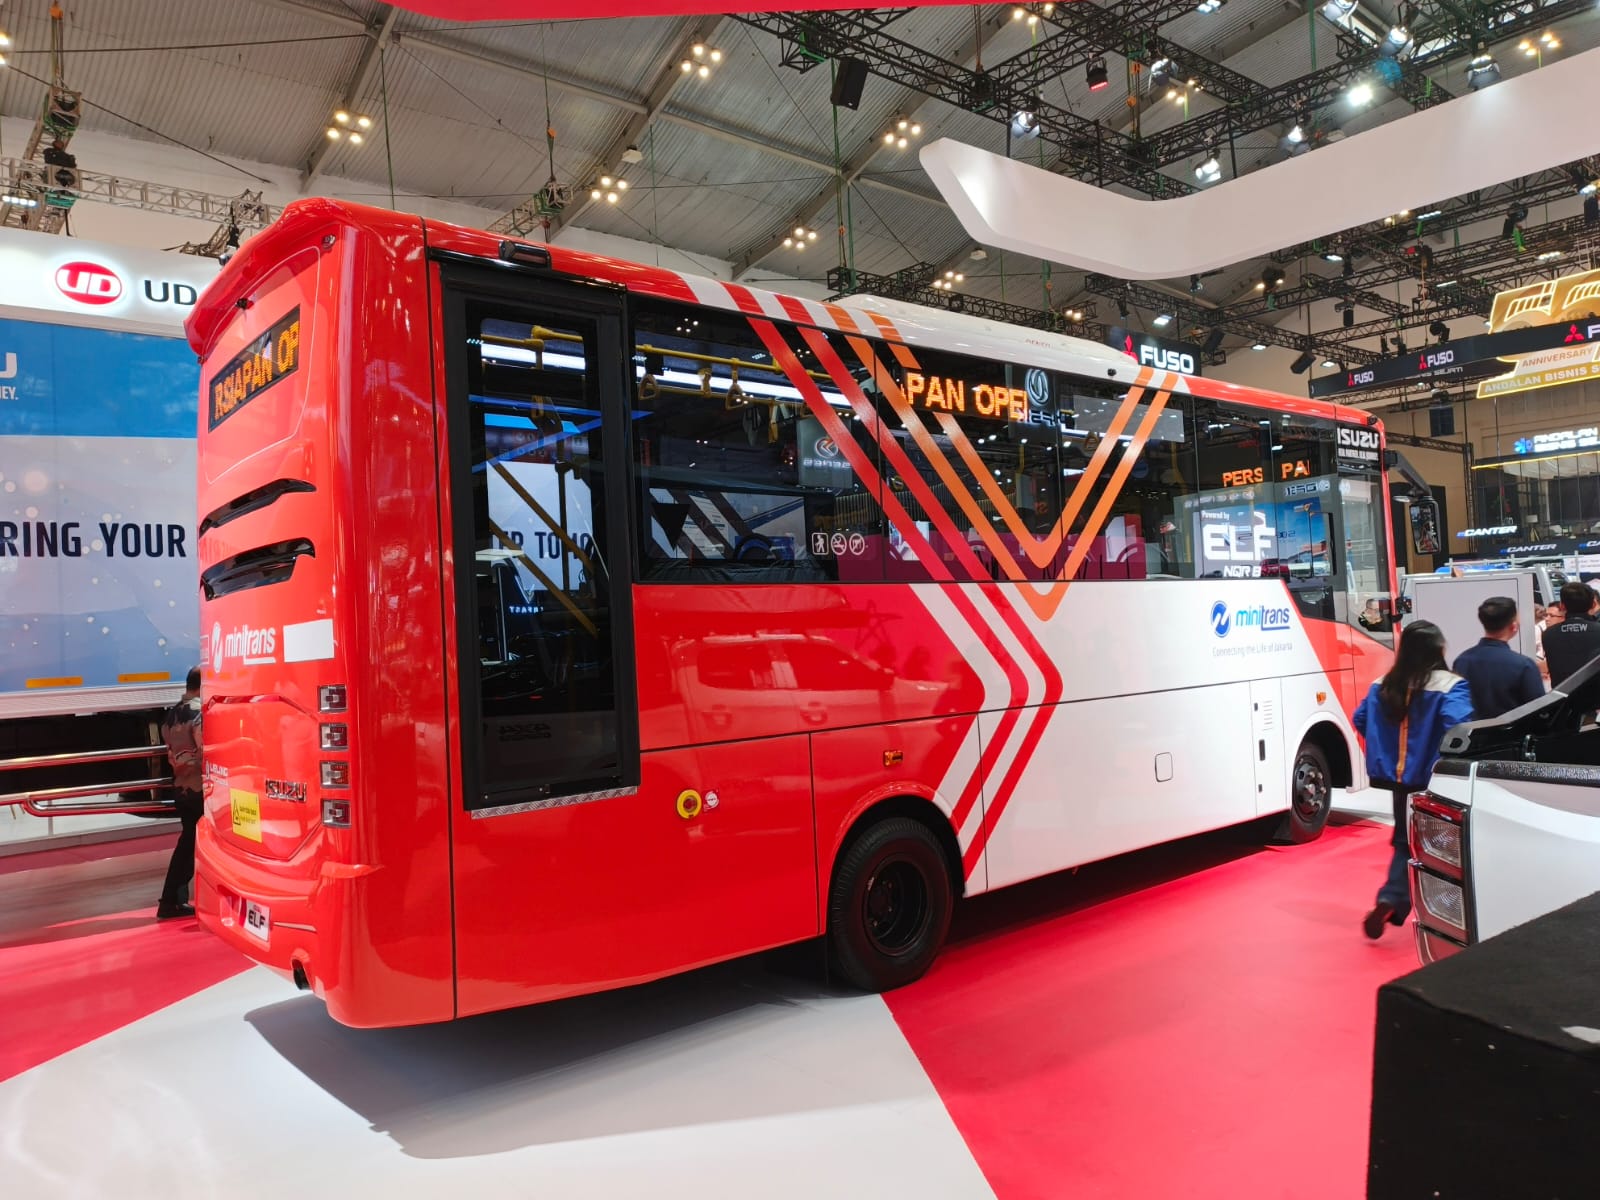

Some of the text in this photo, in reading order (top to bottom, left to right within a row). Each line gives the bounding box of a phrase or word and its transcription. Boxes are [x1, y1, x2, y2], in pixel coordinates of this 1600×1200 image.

[57, 269, 122, 298] UD
[144, 280, 198, 306] UD
[1140, 344, 1194, 374] FUSO
[1427, 350, 1454, 368] FUSO
[1522, 348, 1593, 367] ANNIVERSARY
[1354, 371, 1374, 385] FUSO
[1485, 377, 1541, 393] ANDALAN
[1545, 367, 1587, 384] BISNIS
[0, 385, 19, 400] EY.
[901, 372, 1029, 421] PAN OPE
[1337, 427, 1379, 449] ISUZU
[1221, 459, 1311, 488] PERS PA
[99, 523, 186, 557] YOUR
[1202, 524, 1276, 561] ELF
[1223, 565, 1251, 578] NQR
[1236, 605, 1290, 630] minitrans
[1561, 624, 1588, 632] CREW
[225, 624, 276, 664] minitrans
[265, 779, 307, 803] ISUZU
[248, 909, 266, 930] ELF
